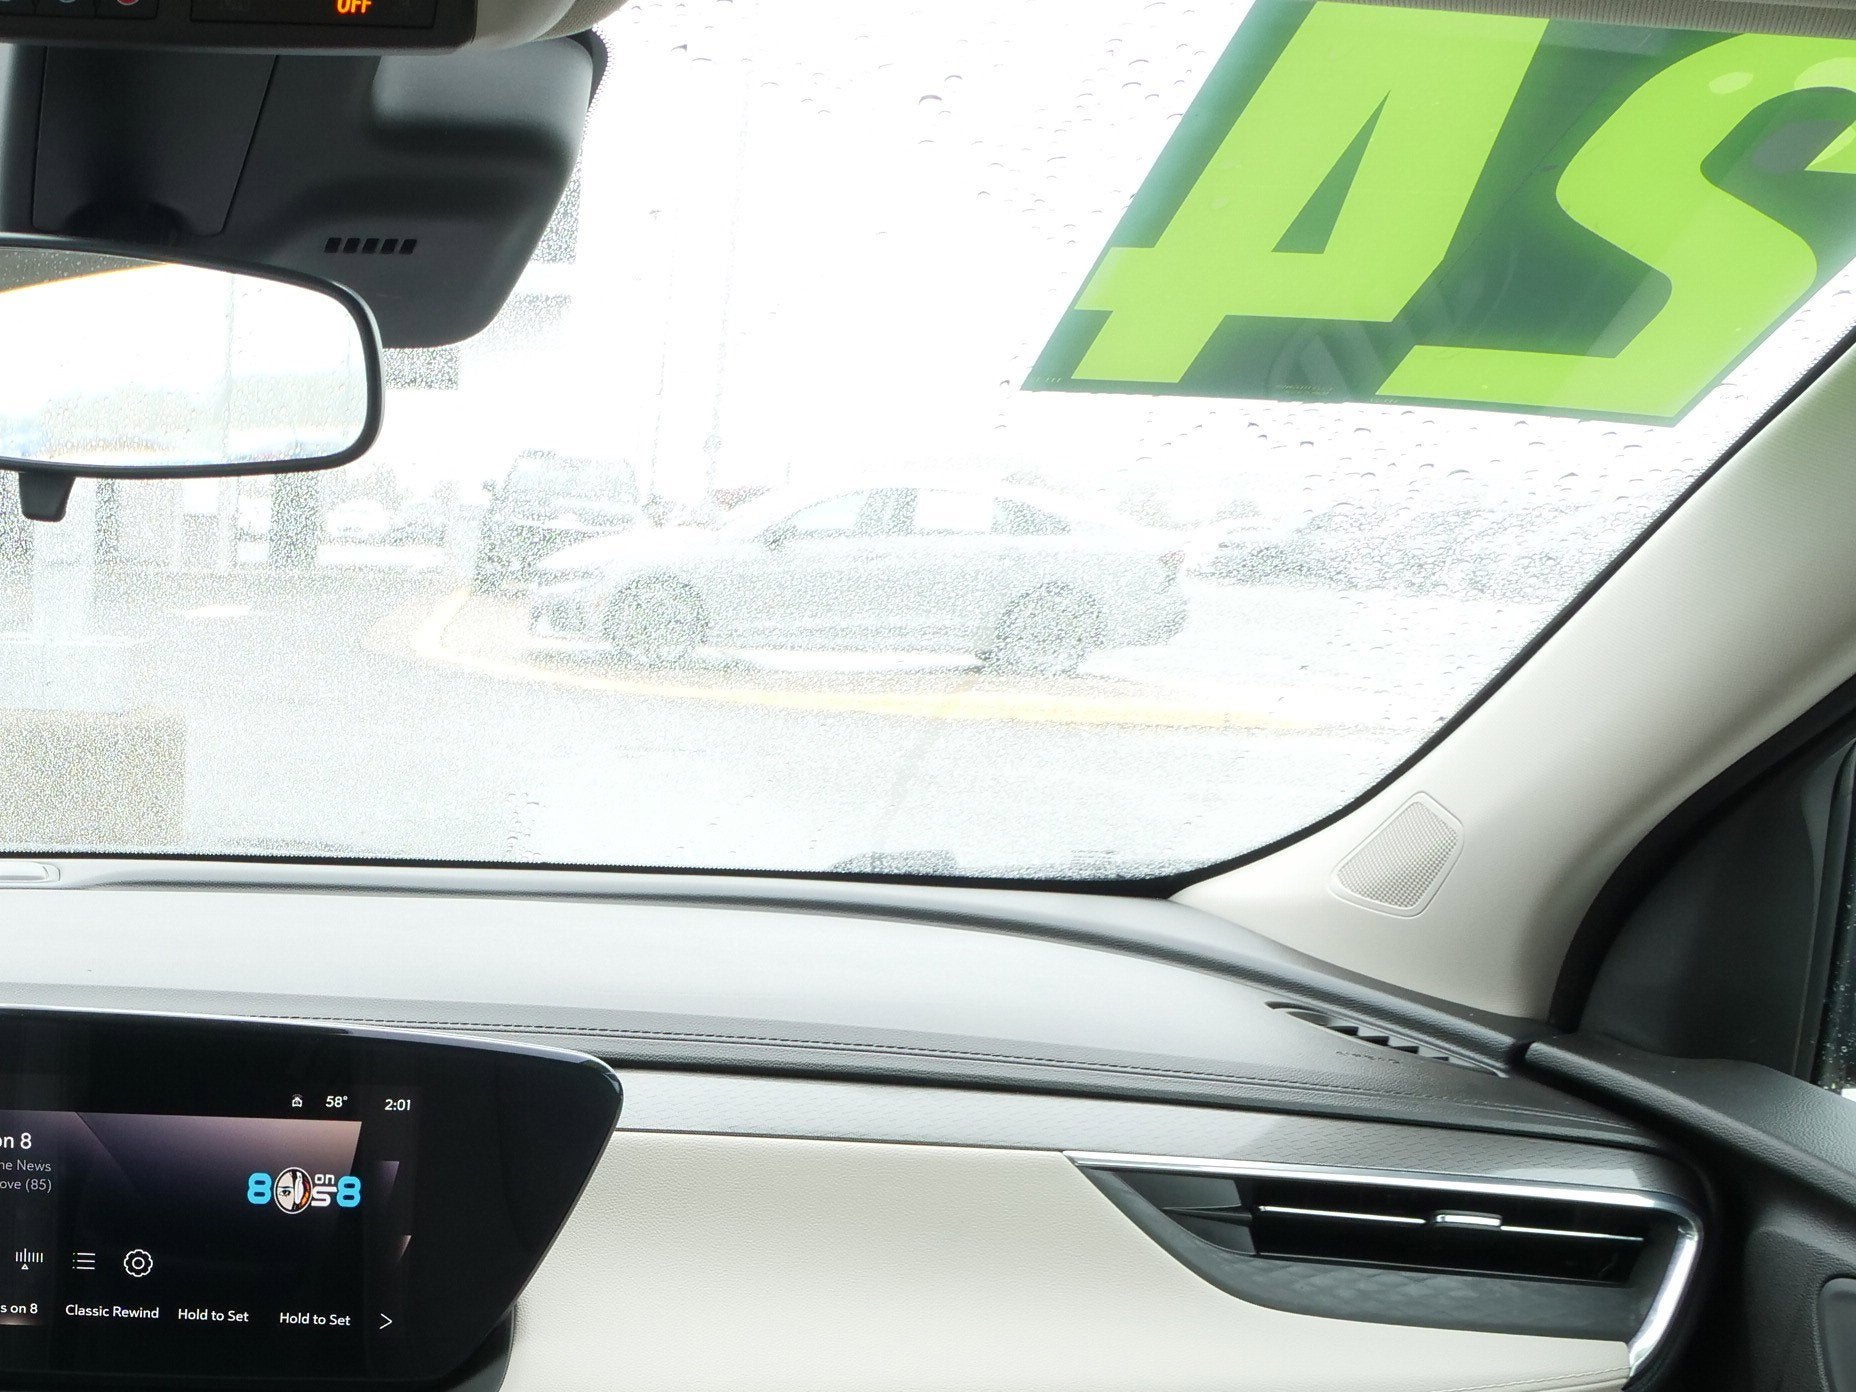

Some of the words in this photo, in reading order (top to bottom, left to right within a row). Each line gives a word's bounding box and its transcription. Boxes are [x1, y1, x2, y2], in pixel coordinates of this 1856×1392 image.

[337, 0, 371, 13] OFF
[325, 1096, 348, 1107] 58°
[384, 1099, 411, 1111] 2:01
[20, 1132, 32, 1149] 8
[17, 1159, 52, 1172] News
[25, 1179, 52, 1193] (85)
[10, 1304, 26, 1314] on
[29, 1303, 38, 1314] 8
[65, 1304, 110, 1317] Classic
[112, 1306, 160, 1319] Rewind
[178, 1308, 208, 1321] Hold
[211, 1310, 225, 1322] to
[227, 1311, 249, 1323] Set
[279, 1312, 310, 1325] Hold
[313, 1314, 326, 1325] to
[329, 1314, 351, 1326] Set
